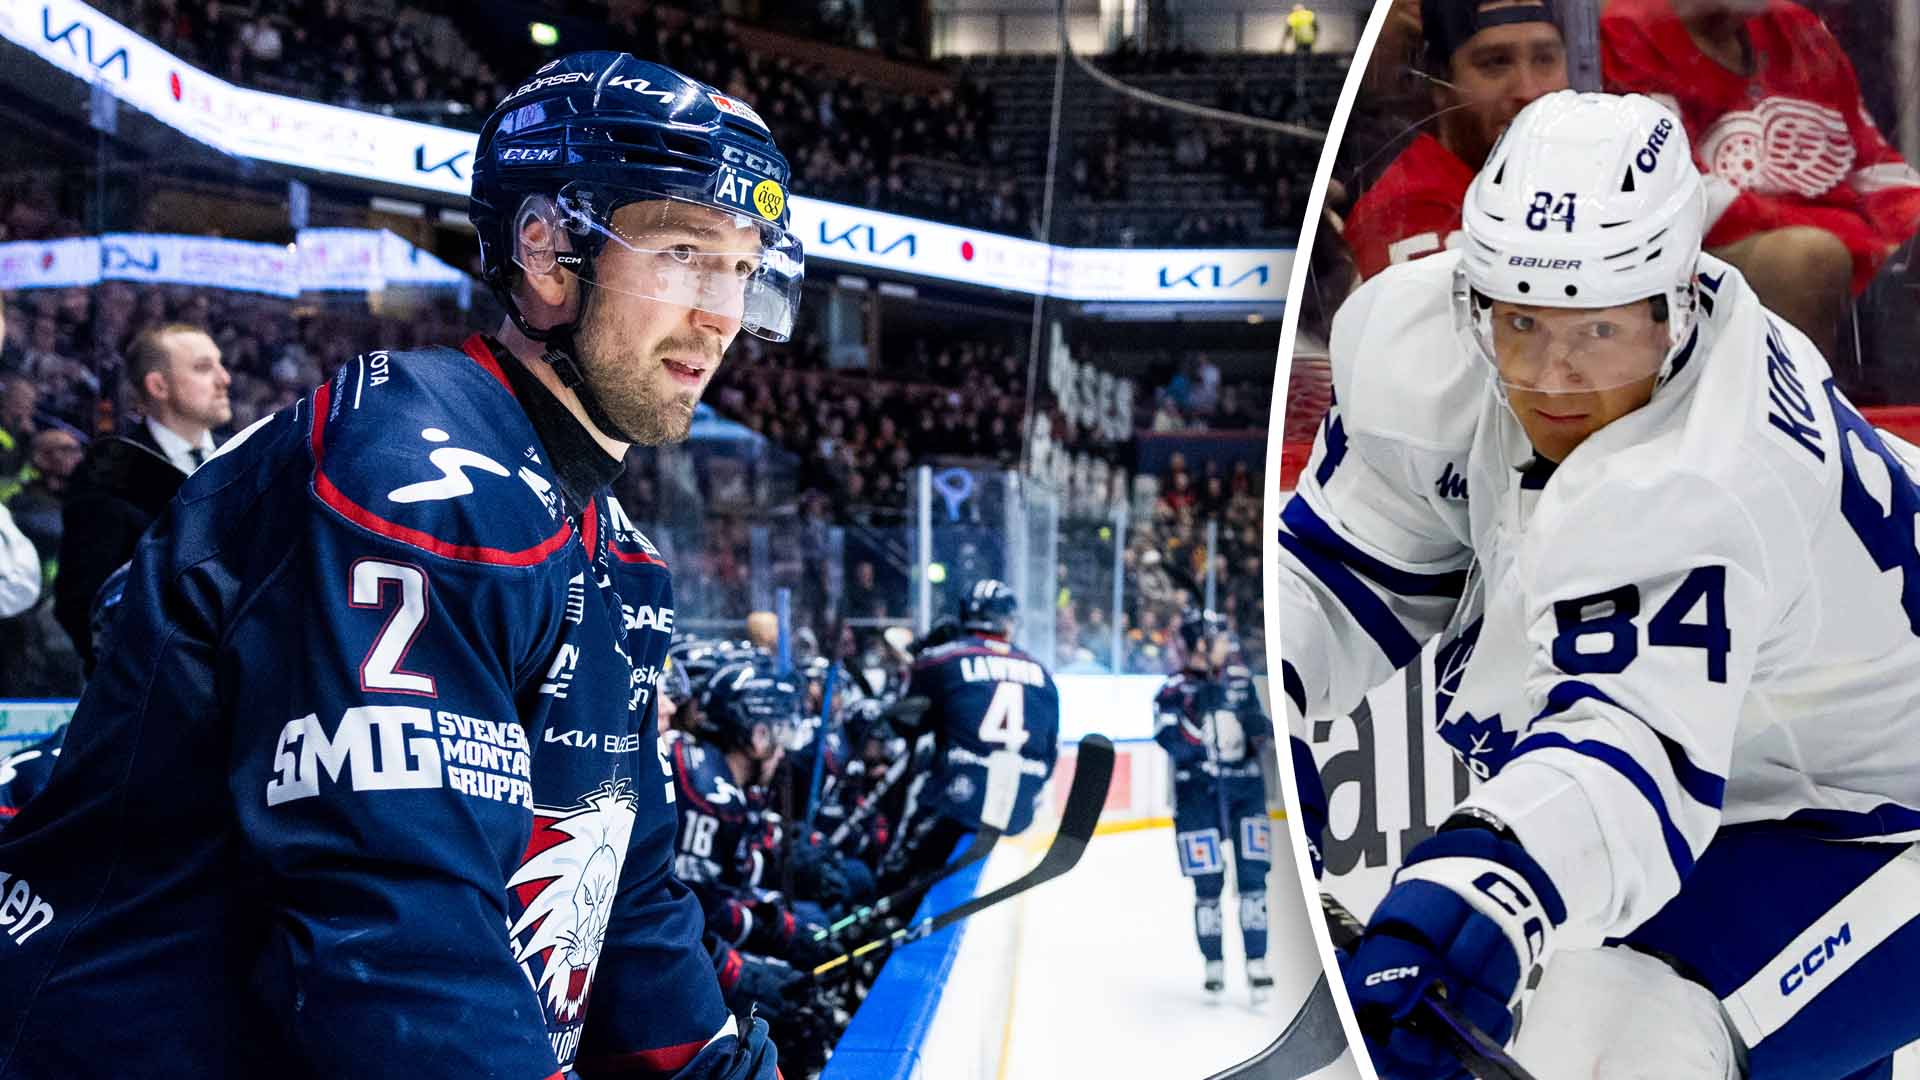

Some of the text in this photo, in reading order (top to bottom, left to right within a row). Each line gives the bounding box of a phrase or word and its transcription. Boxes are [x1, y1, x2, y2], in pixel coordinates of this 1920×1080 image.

[502, 148, 558, 161] CCM
[721, 143, 782, 180] CCM
[1636, 118, 1673, 173] OREO
[717, 166, 781, 216] ÄT ägg
[1525, 191, 1577, 233] 84
[819, 218, 916, 257] KIA
[557, 255, 582, 265] CCM
[1158, 264, 1269, 288] KIA
[1507, 255, 1582, 271] BAUER
[348, 559, 439, 698] 2
[1552, 564, 1731, 684] 84
[437, 710, 530, 756] SVENS
[978, 681, 1030, 753] 4
[266, 705, 443, 807] SMG
[1366, 964, 1420, 987] CCM
[1780, 922, 1852, 997] CCM
